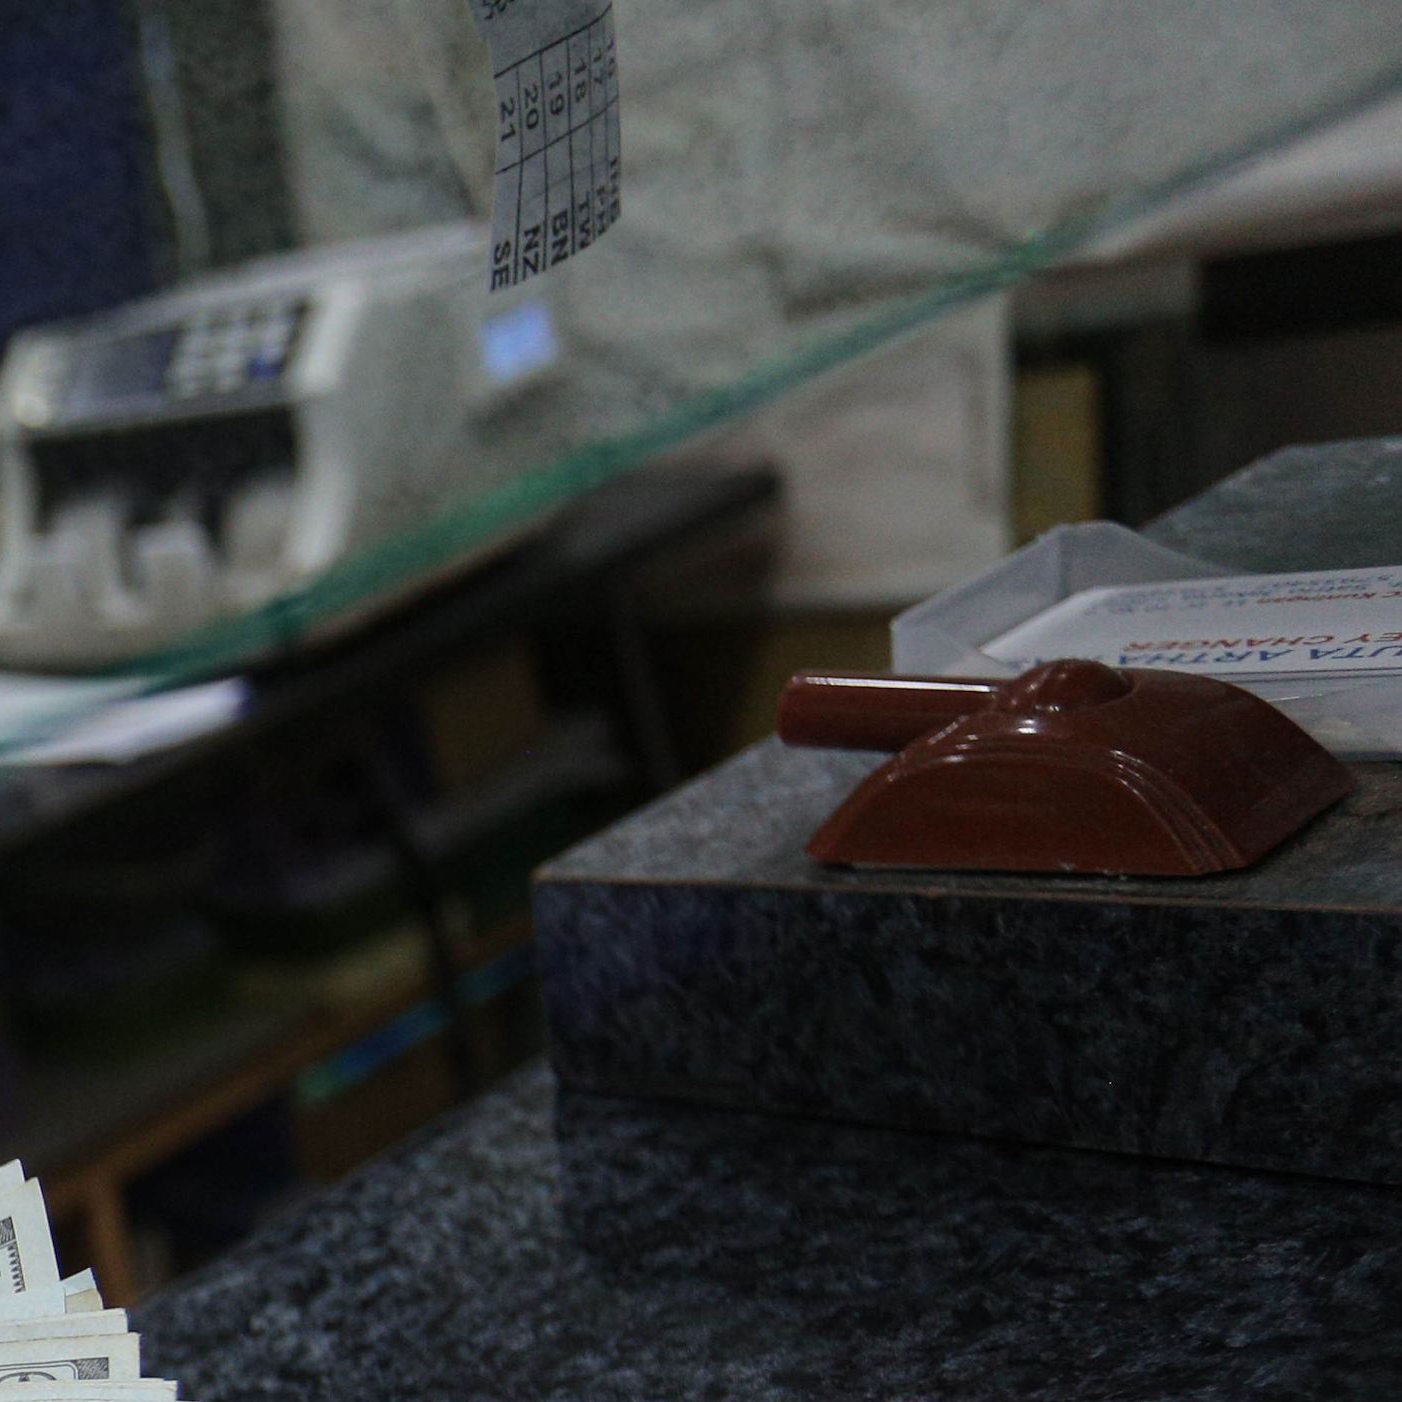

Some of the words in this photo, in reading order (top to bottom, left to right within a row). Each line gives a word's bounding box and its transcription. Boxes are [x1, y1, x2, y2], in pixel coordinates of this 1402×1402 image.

[523, 84, 540, 130] 20
[549, 71, 565, 116] 19
[500, 97, 517, 142] 21
[523, 225, 542, 281] NZ
[551, 208, 569, 266] BN
[490, 240, 512, 292] SE
[1119, 648, 1295, 666] ARTHA
[1121, 635, 1336, 651] CHANGER
